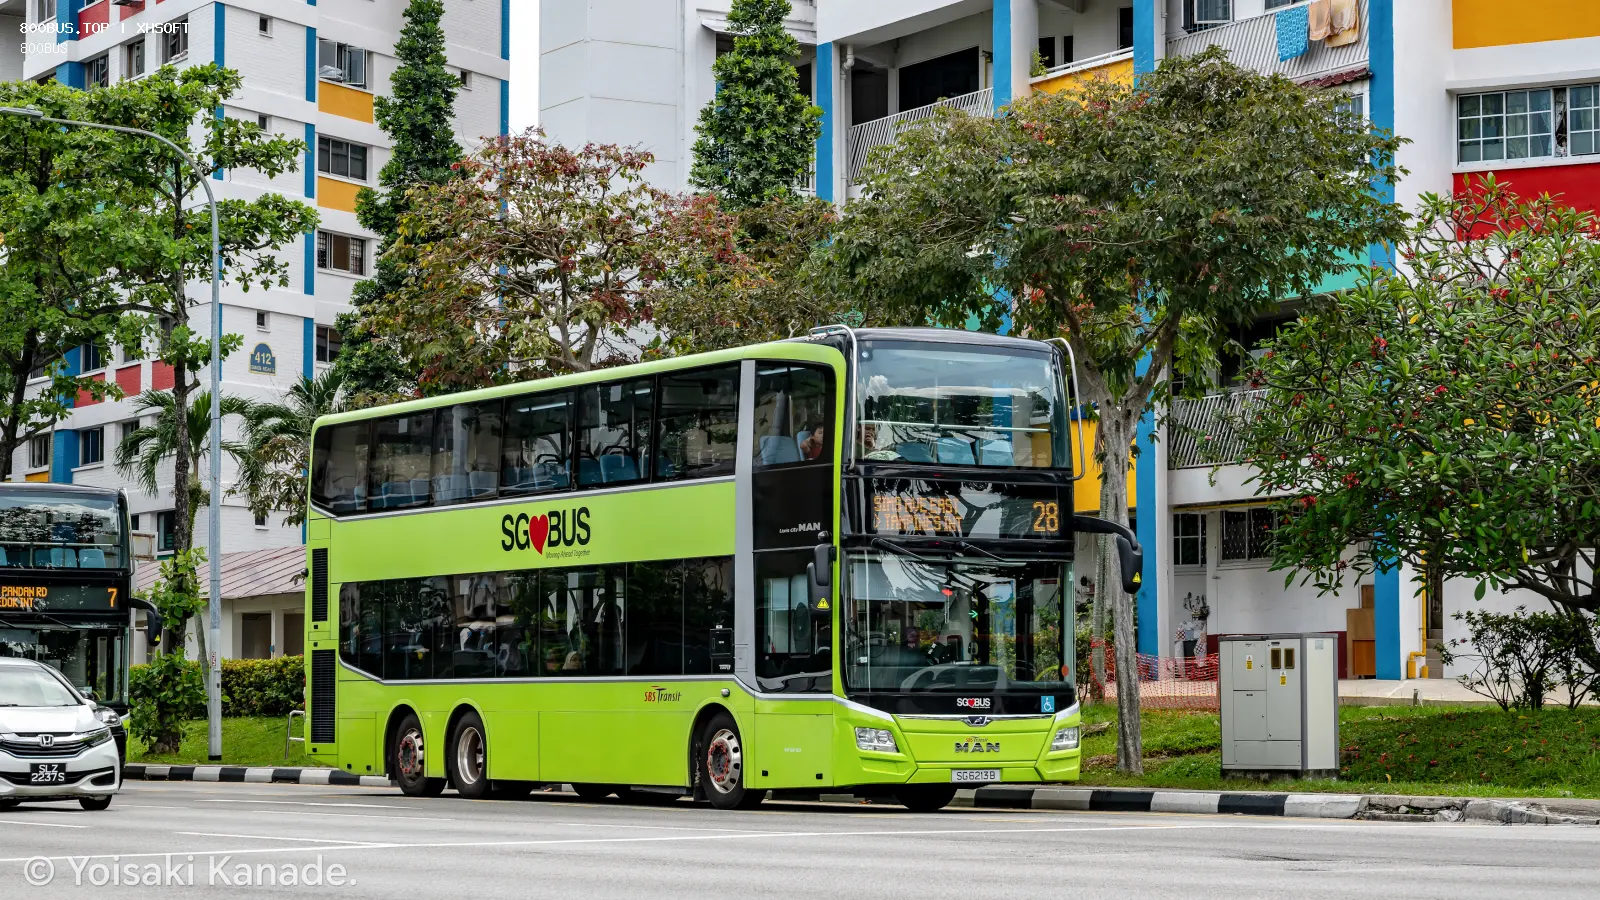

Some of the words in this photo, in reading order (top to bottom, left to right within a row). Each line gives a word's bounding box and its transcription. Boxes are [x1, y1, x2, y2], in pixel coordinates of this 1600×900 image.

[255, 351, 272, 365] 412
[929, 498, 959, 514] EAST
[884, 514, 942, 531] TAMPINES
[1033, 501, 1059, 532] 28
[798, 522, 821, 532] MAN
[1, 586, 35, 597] PANDAN
[36, 587, 48, 598] RD
[107, 588, 118, 608] 7
[19, 597, 34, 608] INT
[644, 691, 656, 702] SBS
[655, 687, 682, 704] Transit
[955, 743, 1000, 753] MAN
[38, 764, 59, 773] SLZ
[31, 772, 65, 782] 2237S
[956, 770, 996, 781] SG6213B
